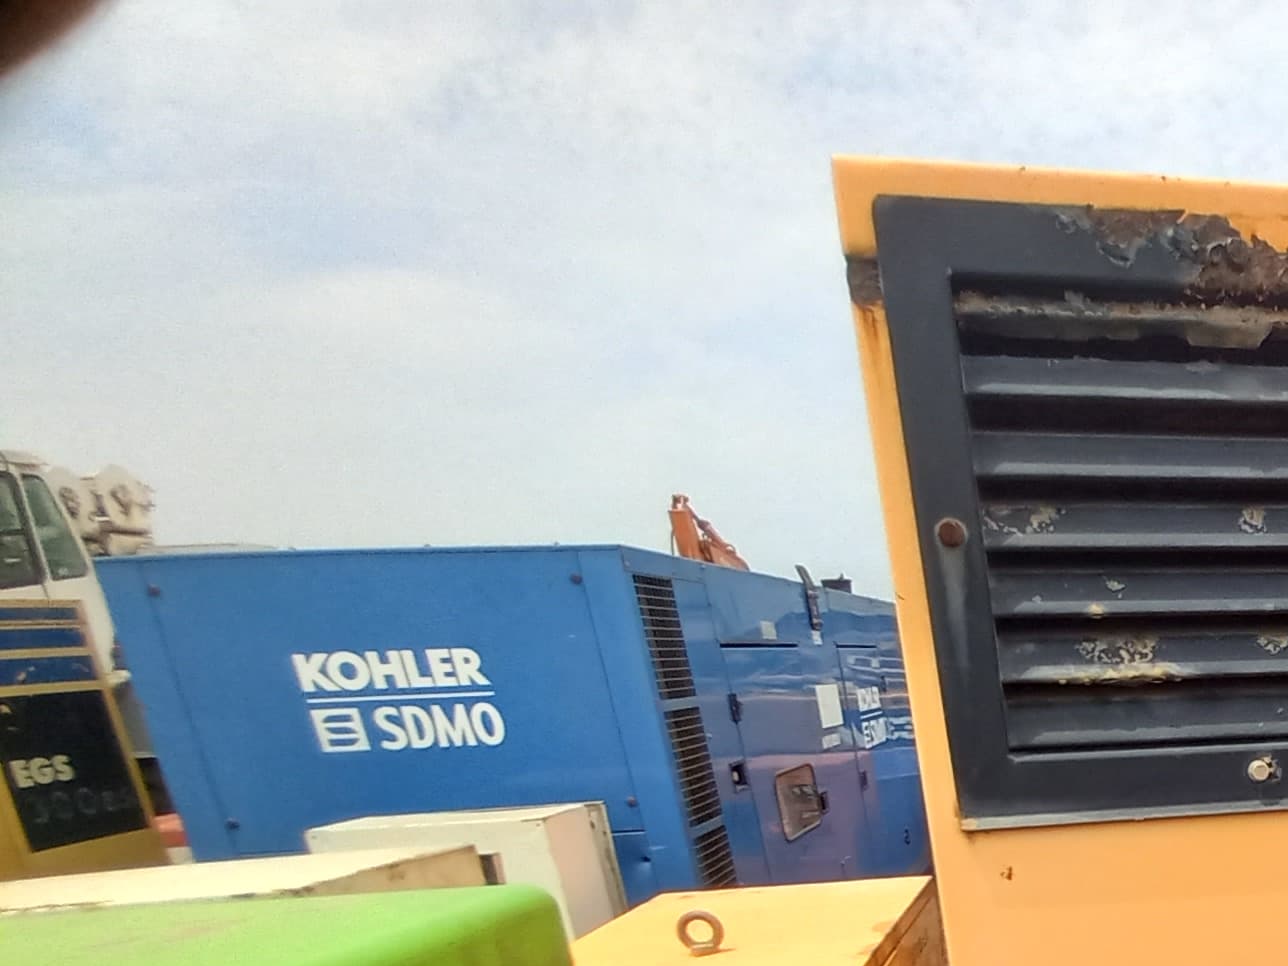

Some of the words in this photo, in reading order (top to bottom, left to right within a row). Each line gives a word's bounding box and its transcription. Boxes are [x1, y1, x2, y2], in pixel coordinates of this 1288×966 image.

[291, 648, 492, 692] KOHLER
[373, 702, 506, 750] SDMO
[9, 754, 76, 788] EGS
